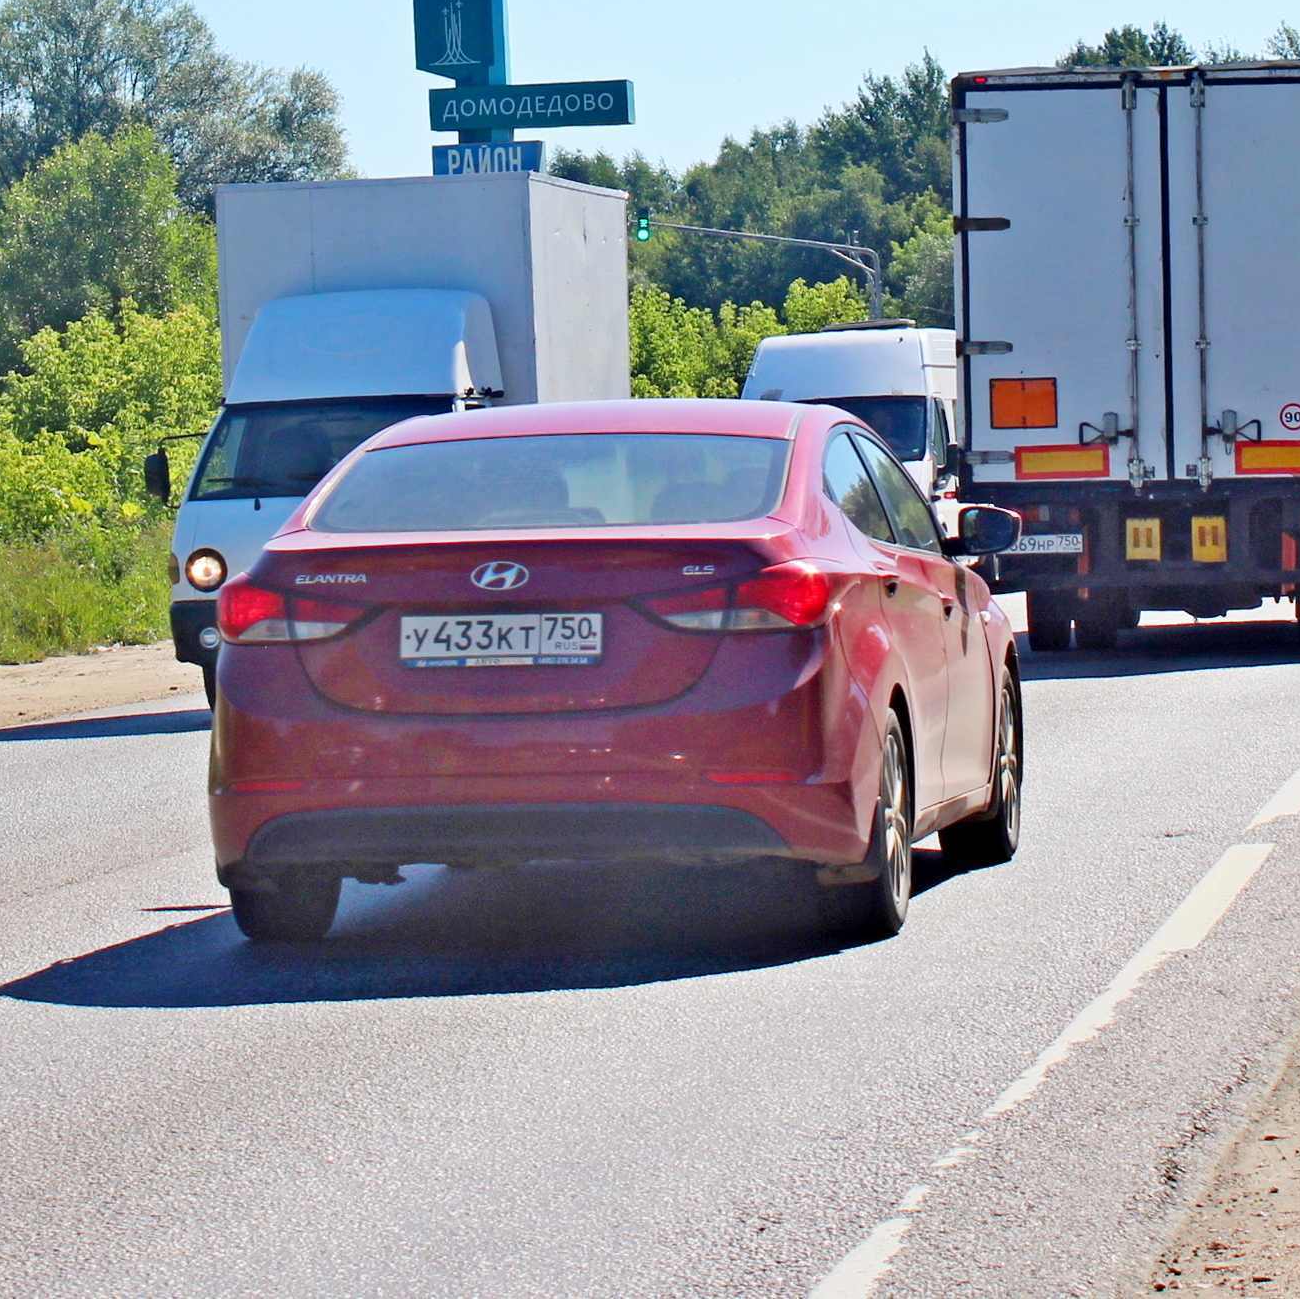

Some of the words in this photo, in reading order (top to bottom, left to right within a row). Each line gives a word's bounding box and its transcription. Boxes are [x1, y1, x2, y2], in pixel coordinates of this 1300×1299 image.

[443, 92, 614, 122] ДОМОДЕДОВО
[1057, 536, 1079, 546] 750
[682, 565, 715, 575] GLS
[295, 573, 368, 585] ELANTRA
[544, 617, 591, 640] 750
[555, 642, 578, 650] RUS
